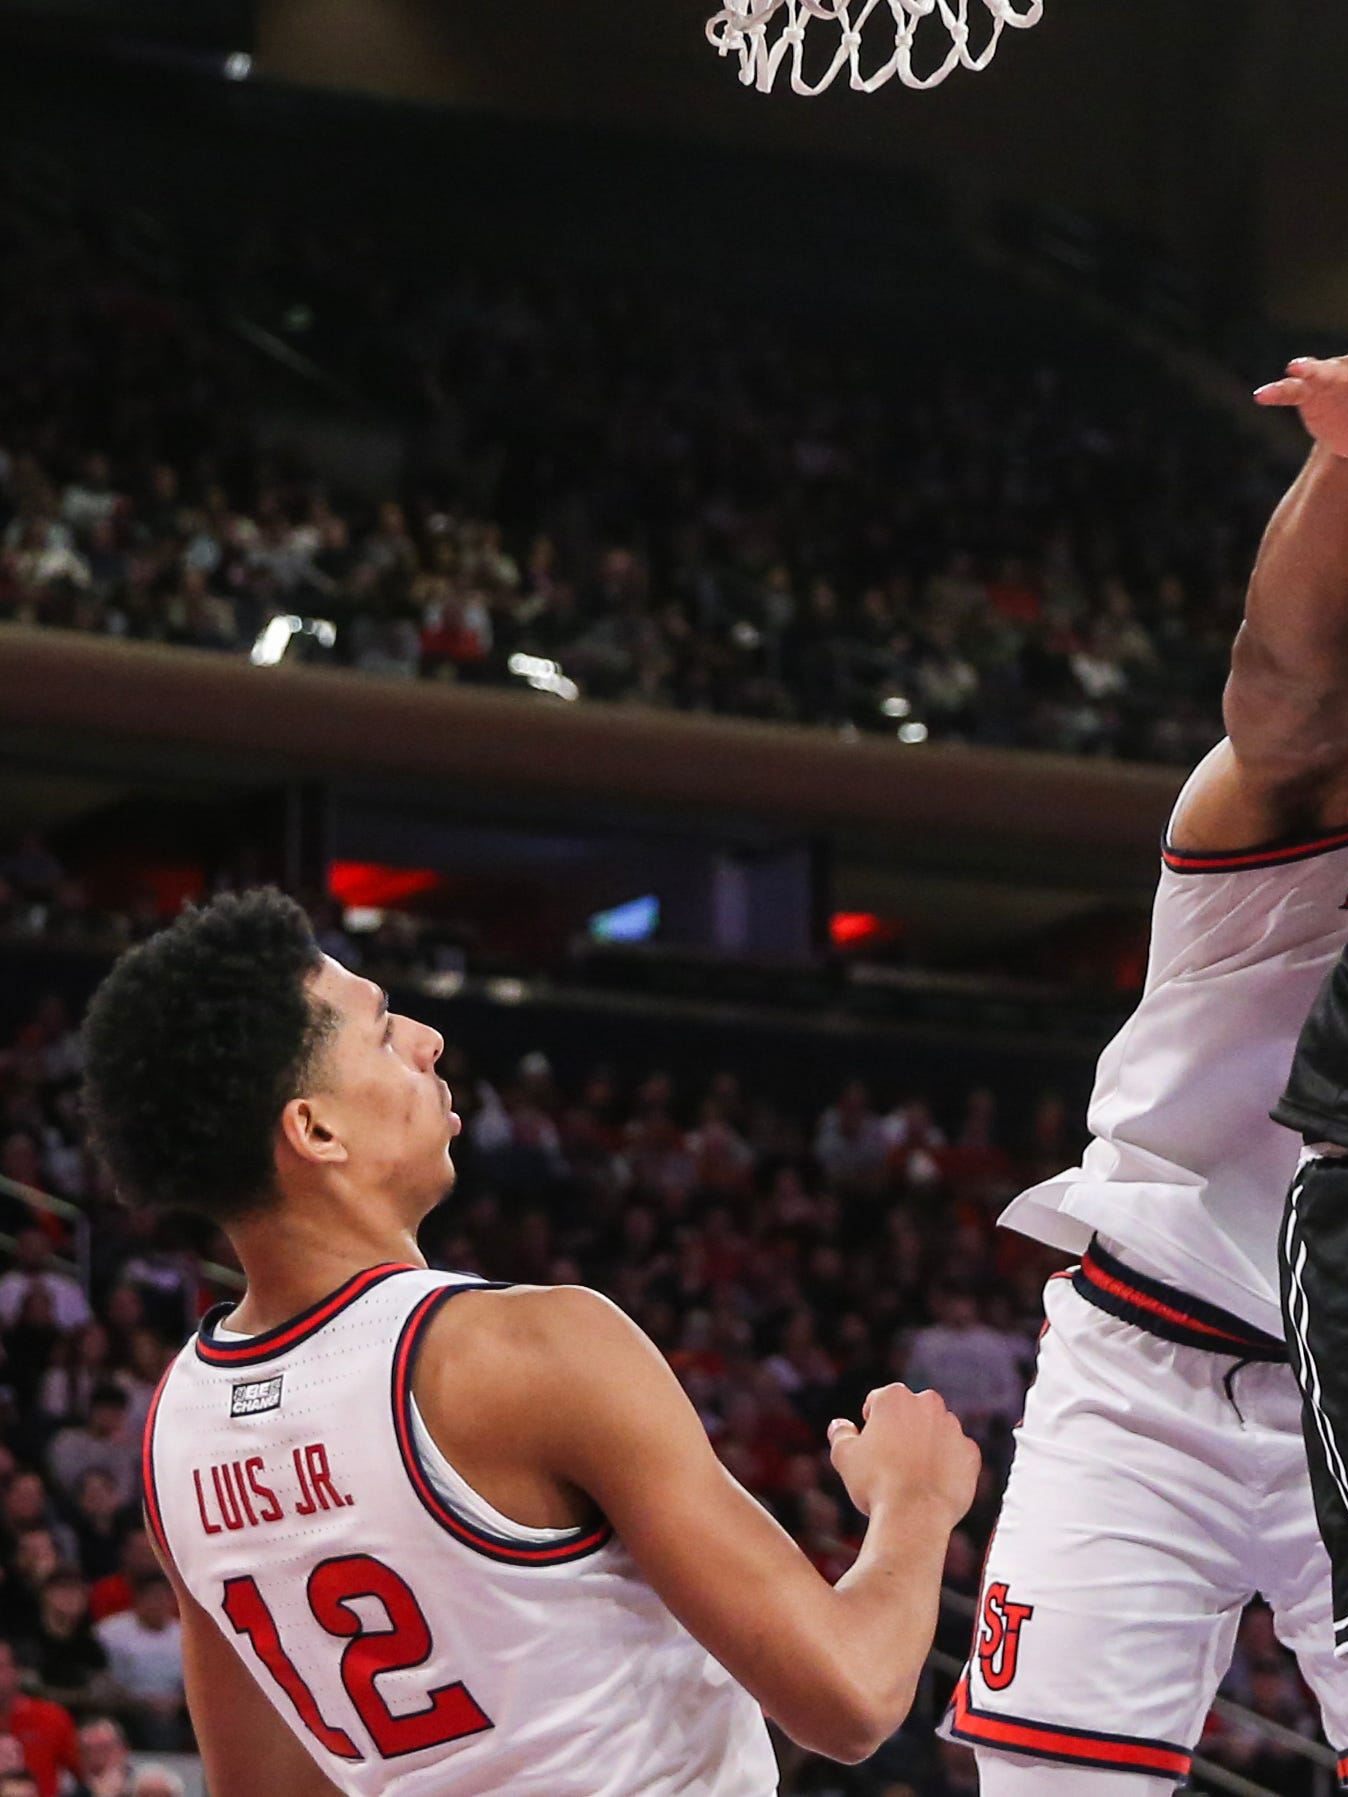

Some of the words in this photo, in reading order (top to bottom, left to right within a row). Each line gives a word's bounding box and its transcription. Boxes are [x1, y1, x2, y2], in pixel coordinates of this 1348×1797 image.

[193, 1456, 283, 1534] LUIS
[292, 1443, 355, 1516] JR.
[221, 1553, 495, 1761] 12
